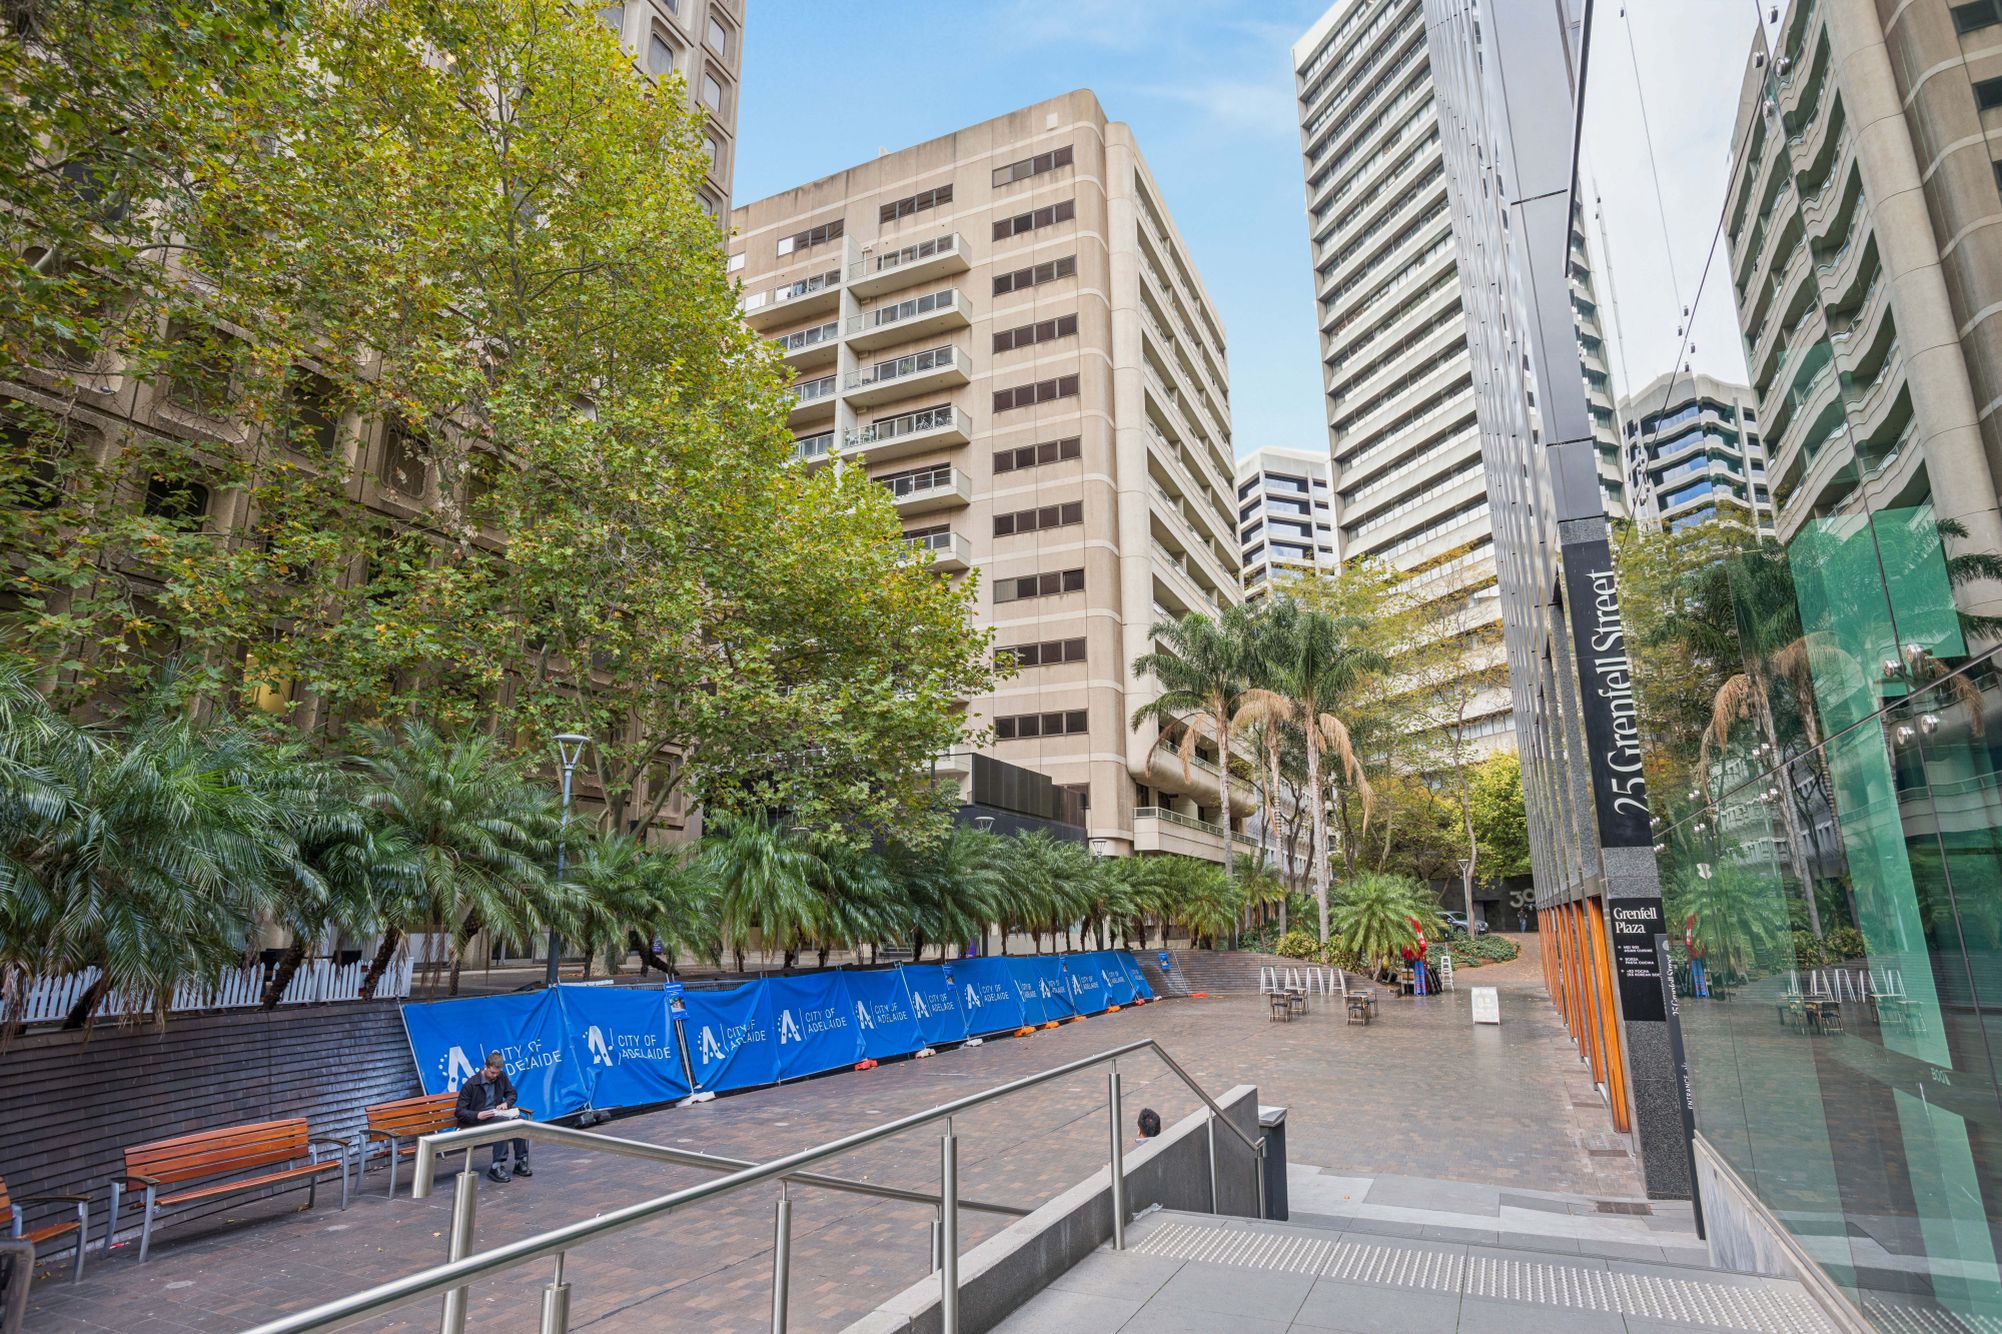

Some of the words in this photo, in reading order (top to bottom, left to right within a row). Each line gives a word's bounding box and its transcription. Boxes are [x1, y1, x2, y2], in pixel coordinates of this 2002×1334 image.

[1586, 569, 1625, 652] Street
[1595, 656, 1643, 772] Grenfell
[1611, 777, 1649, 815] 25
[1510, 888, 1535, 908] 30
[1613, 907, 1657, 920] Grenfell
[1615, 921, 1646, 934] Plaza
[928, 994, 939, 1004] CITY
[984, 991, 1009, 1002] ADELAIDE
[805, 1010, 822, 1022] CITY
[824, 1008, 836, 1019] OF
[874, 1004, 889, 1014] CITY
[878, 1011, 908, 1024] ADELAIDE
[727, 1024, 747, 1039] CITY
[808, 1017, 847, 1034] ADELAIDE
[618, 1035, 640, 1047] CITY
[644, 1034, 657, 1047] OF
[622, 1046, 671, 1060] ADELAIDE
[505, 1050, 562, 1076] DELAIDE
[1683, 1075, 1693, 1110] ENTRANCE
